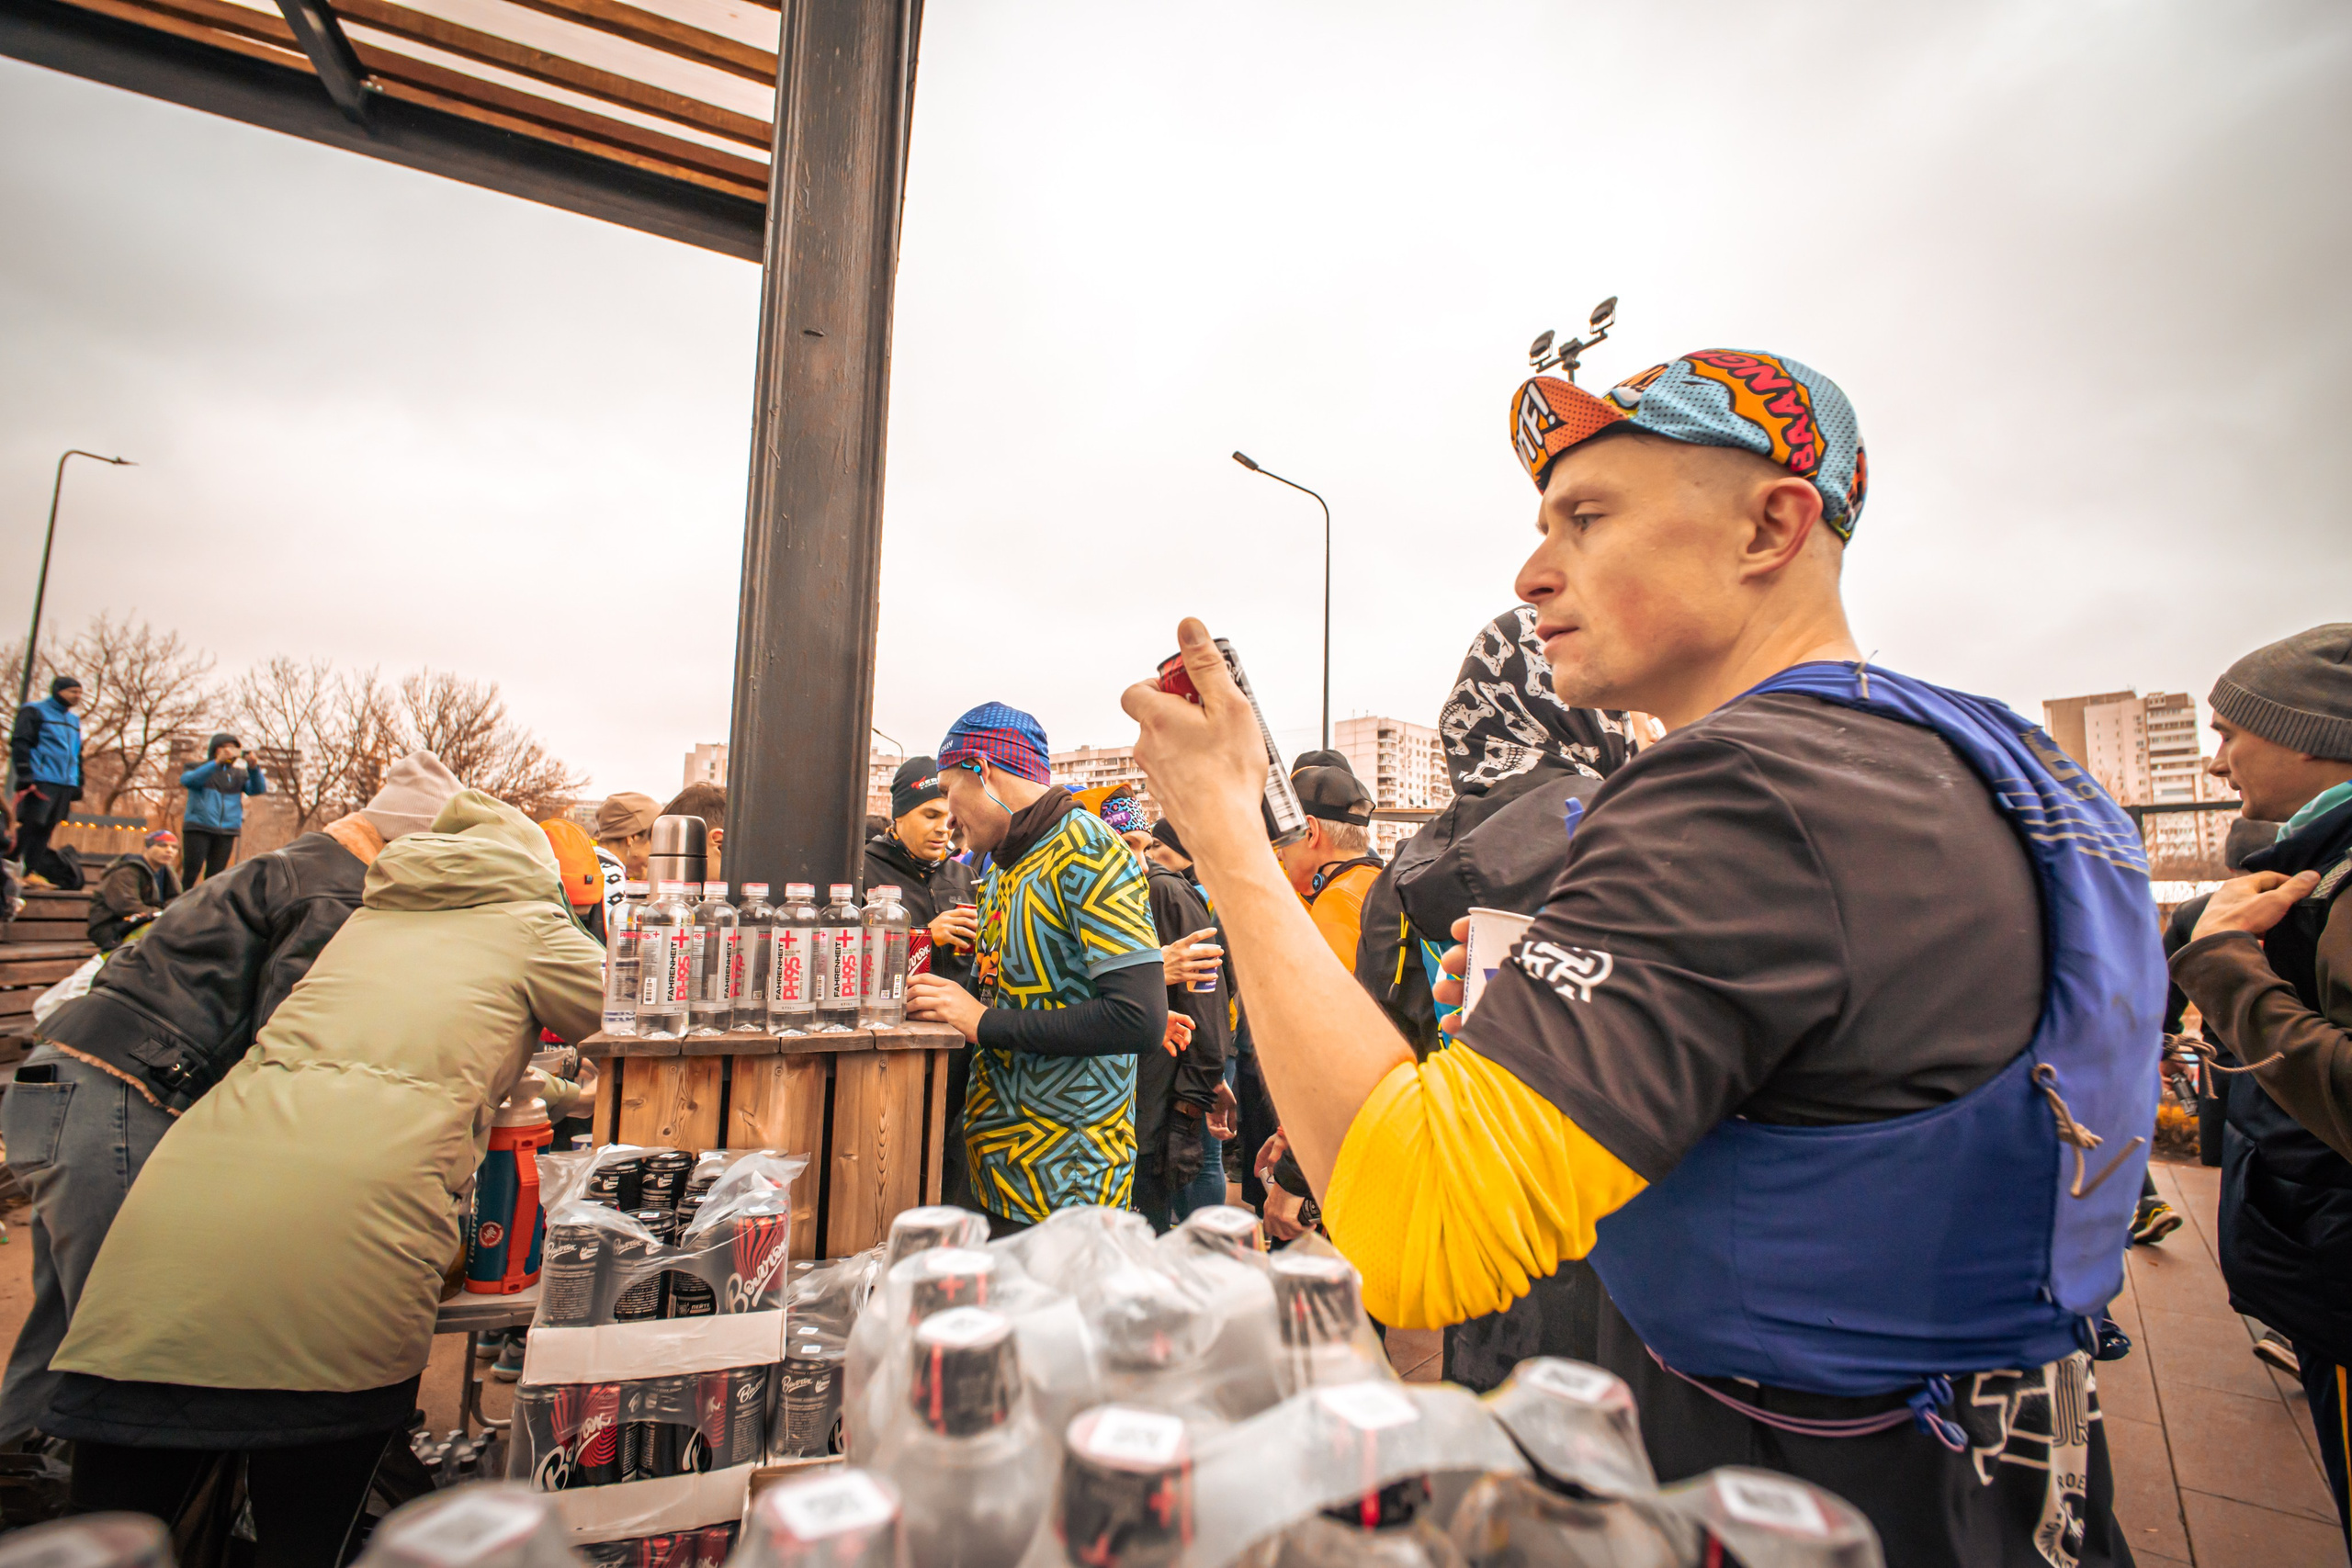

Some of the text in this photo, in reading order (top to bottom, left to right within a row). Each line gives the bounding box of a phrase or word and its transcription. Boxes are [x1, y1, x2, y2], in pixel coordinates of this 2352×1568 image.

[1103, 812, 1126, 826] ORT
[667, 942, 677, 1001] FAHRENHEIT
[724, 942, 732, 998] FAHRENHEIT
[775, 943, 784, 1000] FAHRENHEIT
[833, 942, 842, 998] FAHRENHEIT
